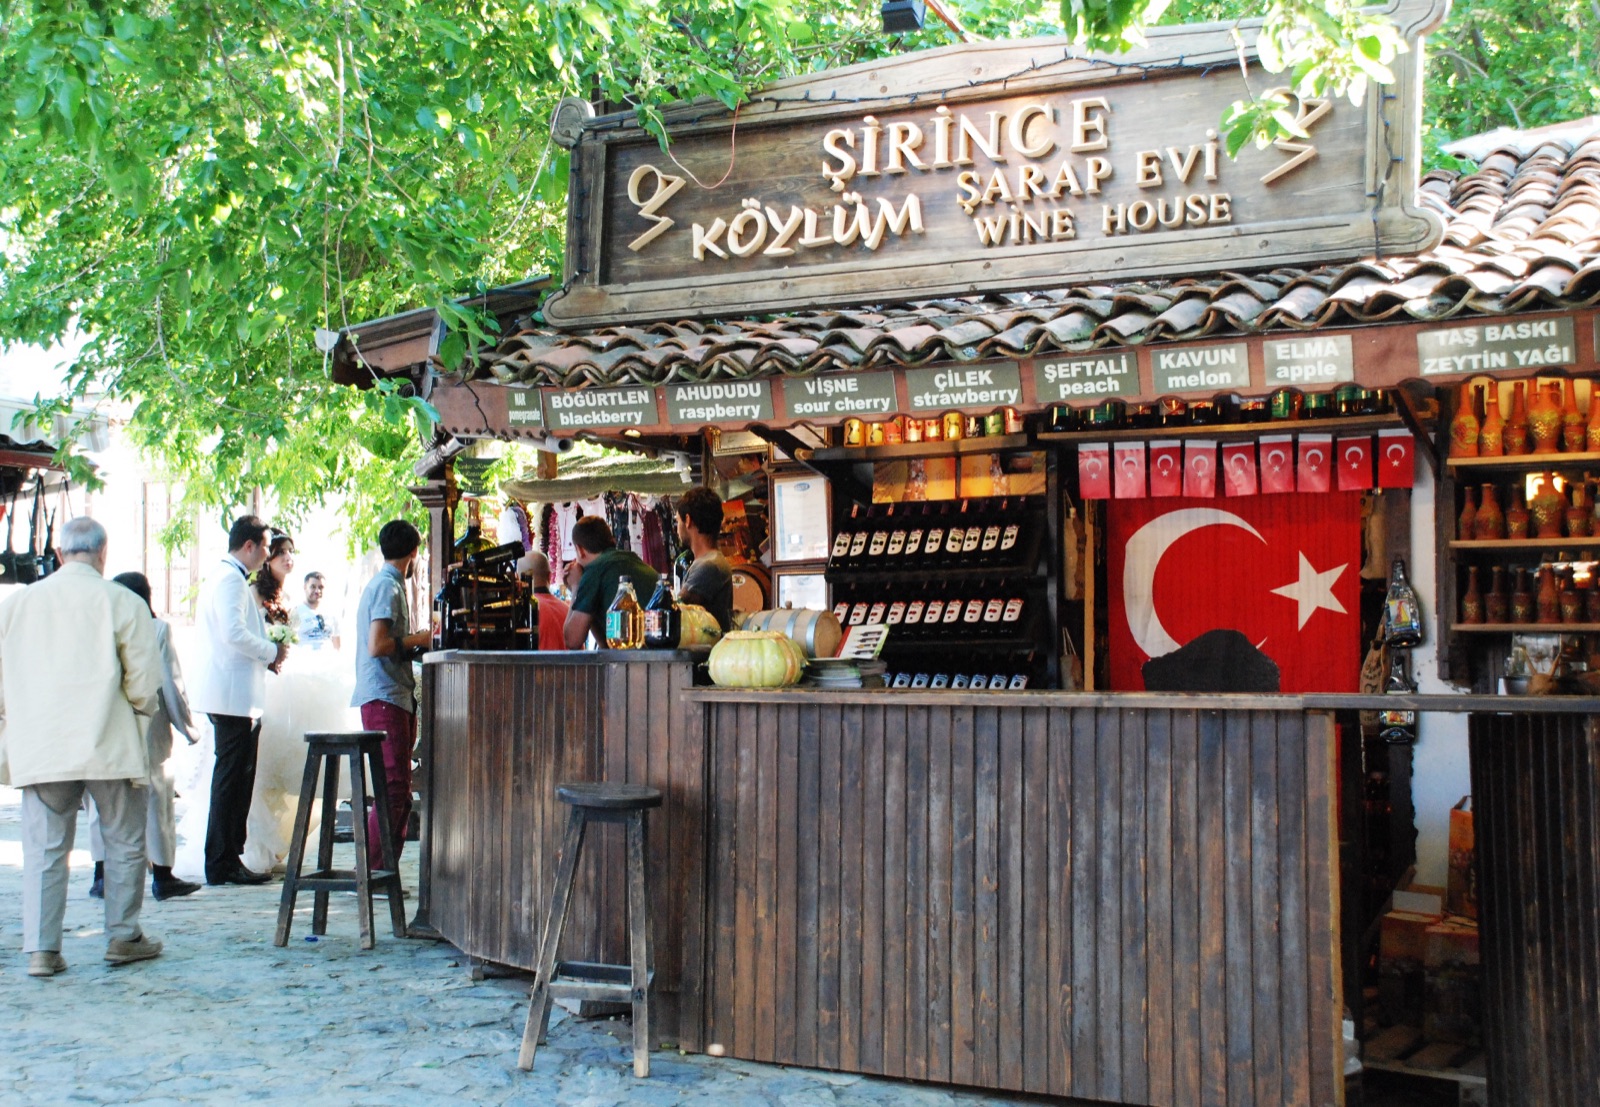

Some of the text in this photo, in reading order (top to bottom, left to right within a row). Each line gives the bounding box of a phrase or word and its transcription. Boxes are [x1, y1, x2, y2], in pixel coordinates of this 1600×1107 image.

[822, 97, 1111, 190] ŞİRİNCE
[956, 127, 1219, 214] ŞARAP EVİ
[1102, 193, 1232, 235] HOUSE
[691, 191, 925, 262] KÖYLÜM
[1434, 321, 1556, 347] TAŞ BASKI
[1159, 348, 1237, 370] KAVUN
[1275, 339, 1340, 360] ELMA
[1424, 344, 1570, 374] ZEYTİN YAĞI
[1044, 355, 1128, 382] ŞEFTALİ
[1168, 367, 1232, 388] melon
[1276, 361, 1337, 380] apple
[805, 376, 859, 396] VİŞNE
[934, 369, 993, 390] ÇİLEK
[1059, 377, 1120, 399] peach
[551, 390, 650, 409] BÖĞÜRTLEN
[675, 382, 762, 402] AHUDUDU
[913, 386, 1019, 410] strawberry
[679, 402, 761, 421] raspberry
[794, 396, 891, 414] sour cherry
[560, 410, 643, 425] blackberry
